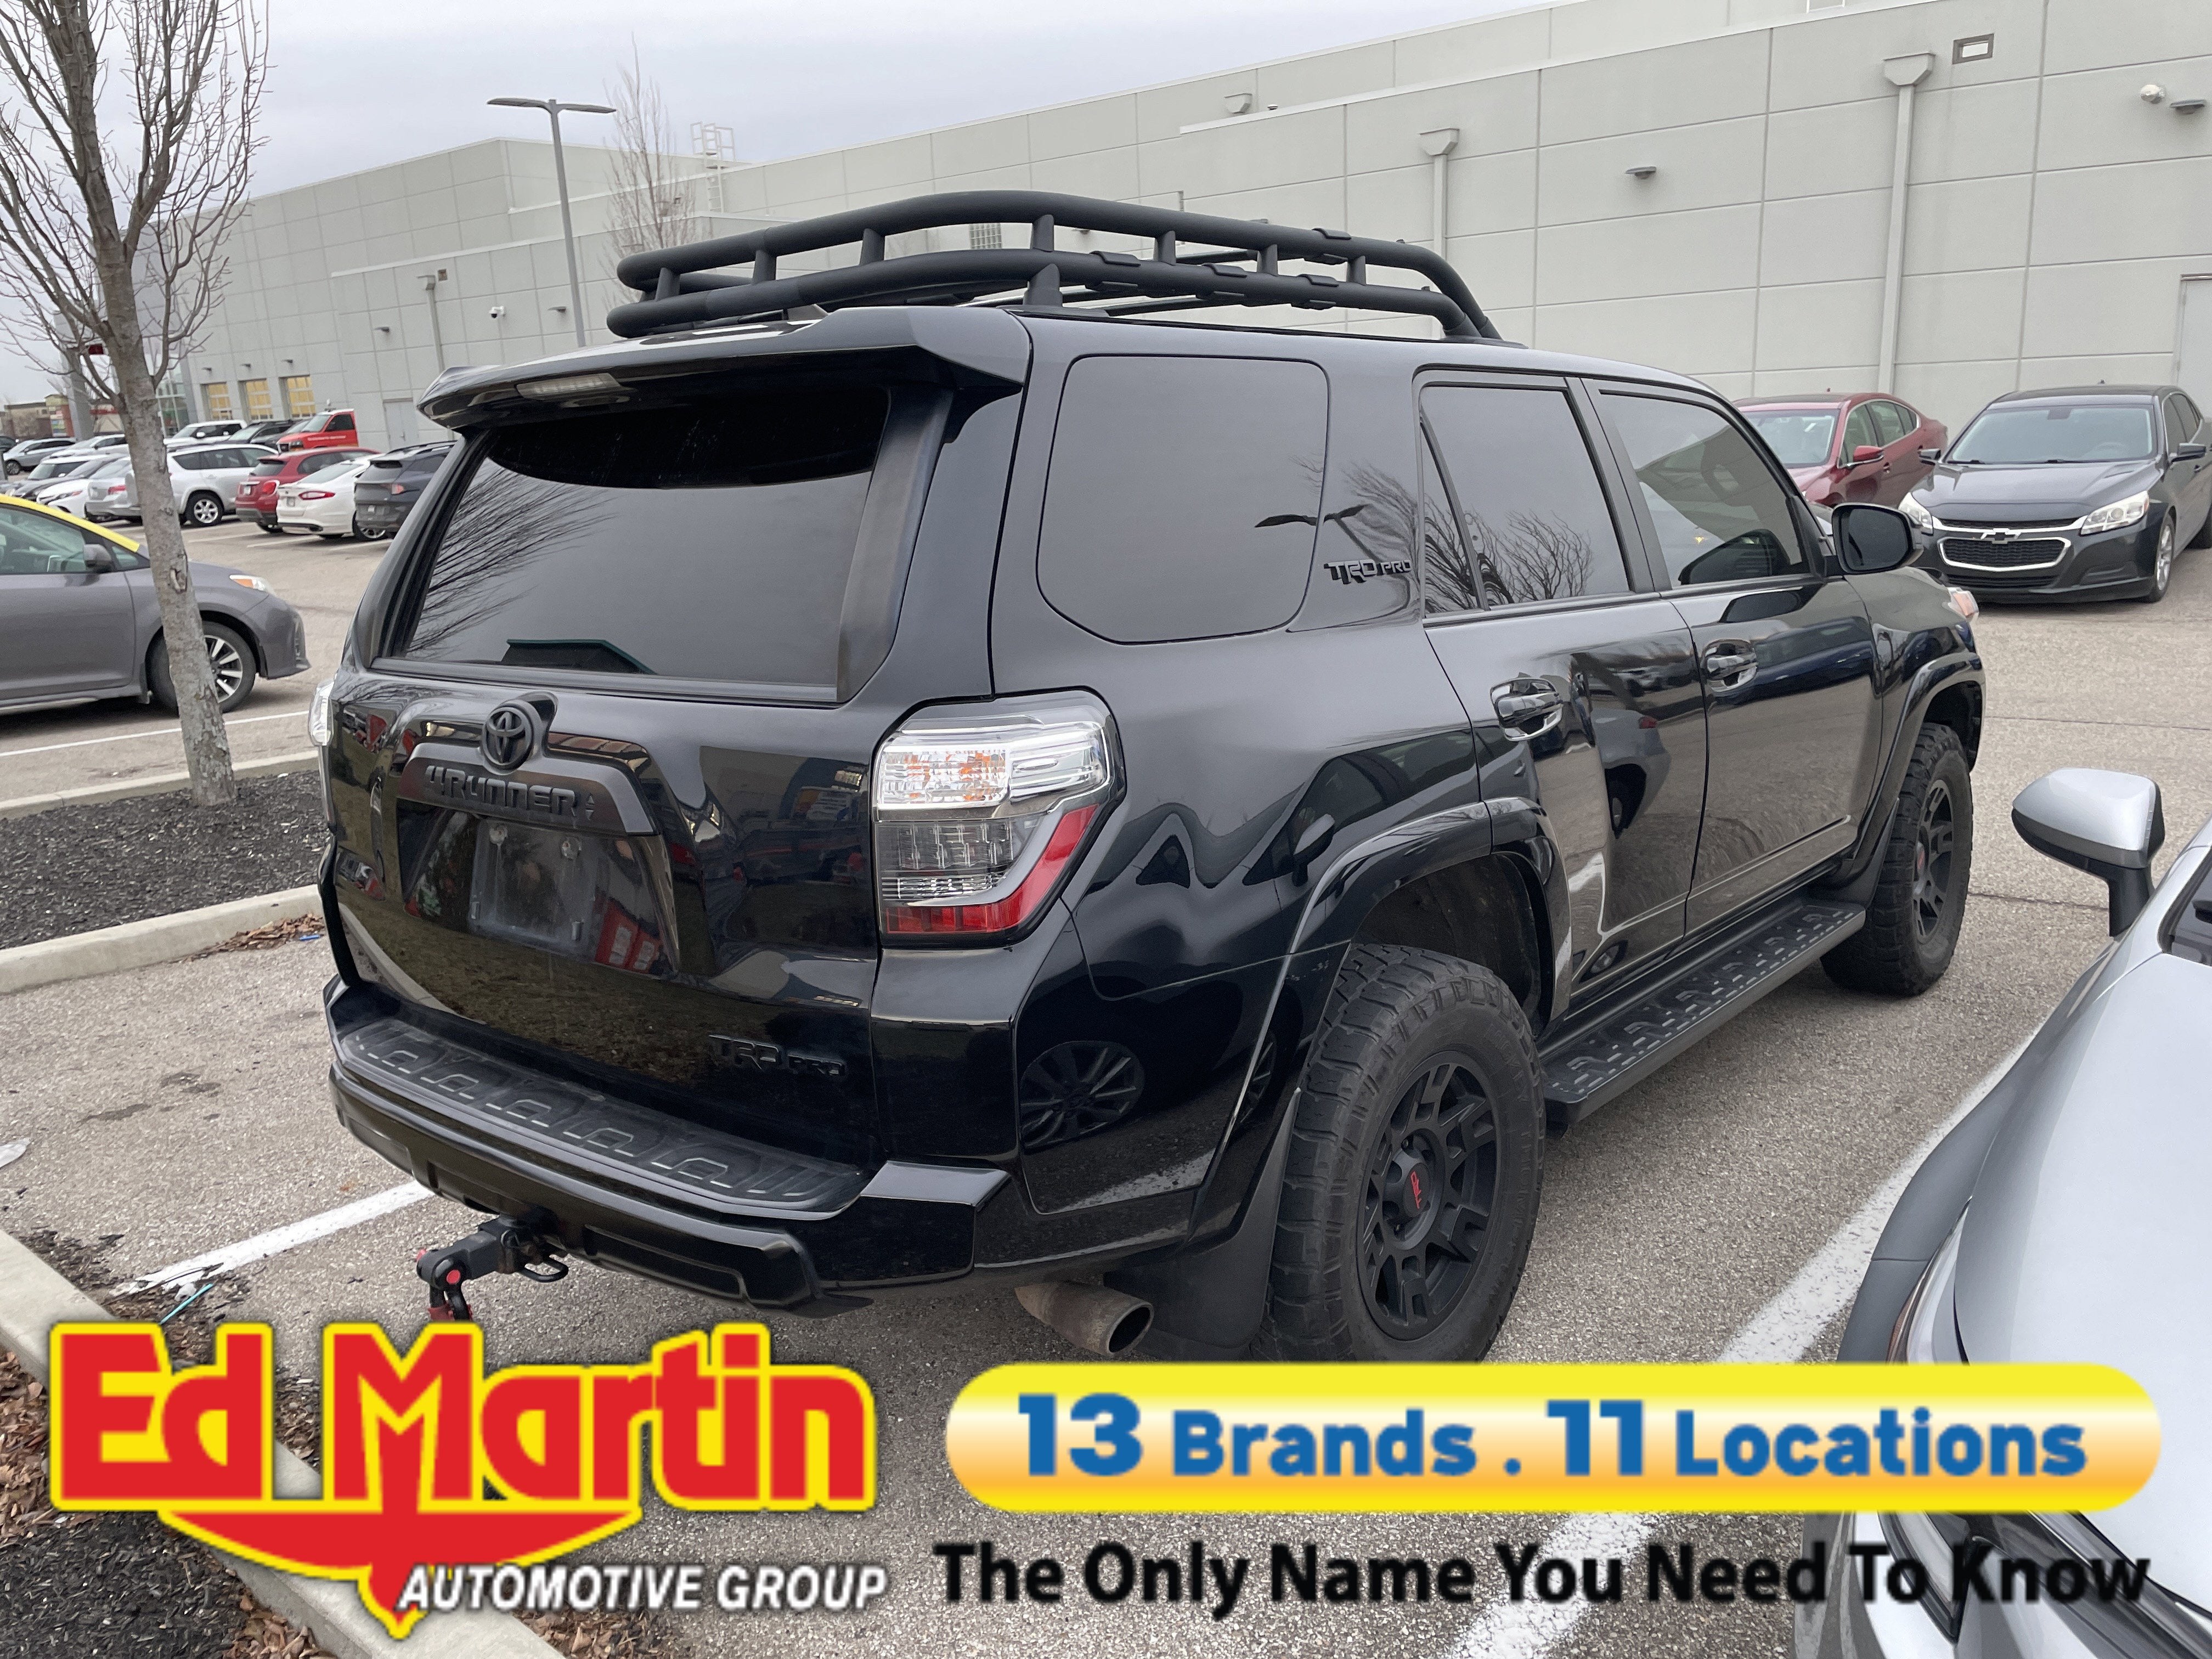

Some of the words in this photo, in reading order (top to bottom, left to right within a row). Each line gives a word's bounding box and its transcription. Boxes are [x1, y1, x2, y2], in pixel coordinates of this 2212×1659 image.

[1324, 559, 1378, 584] TRD
[1378, 560, 1413, 575] PRO
[425, 765, 578, 817] 4RUNNER
[708, 1034, 782, 1071] TRD
[786, 1049, 847, 1077] PRO
